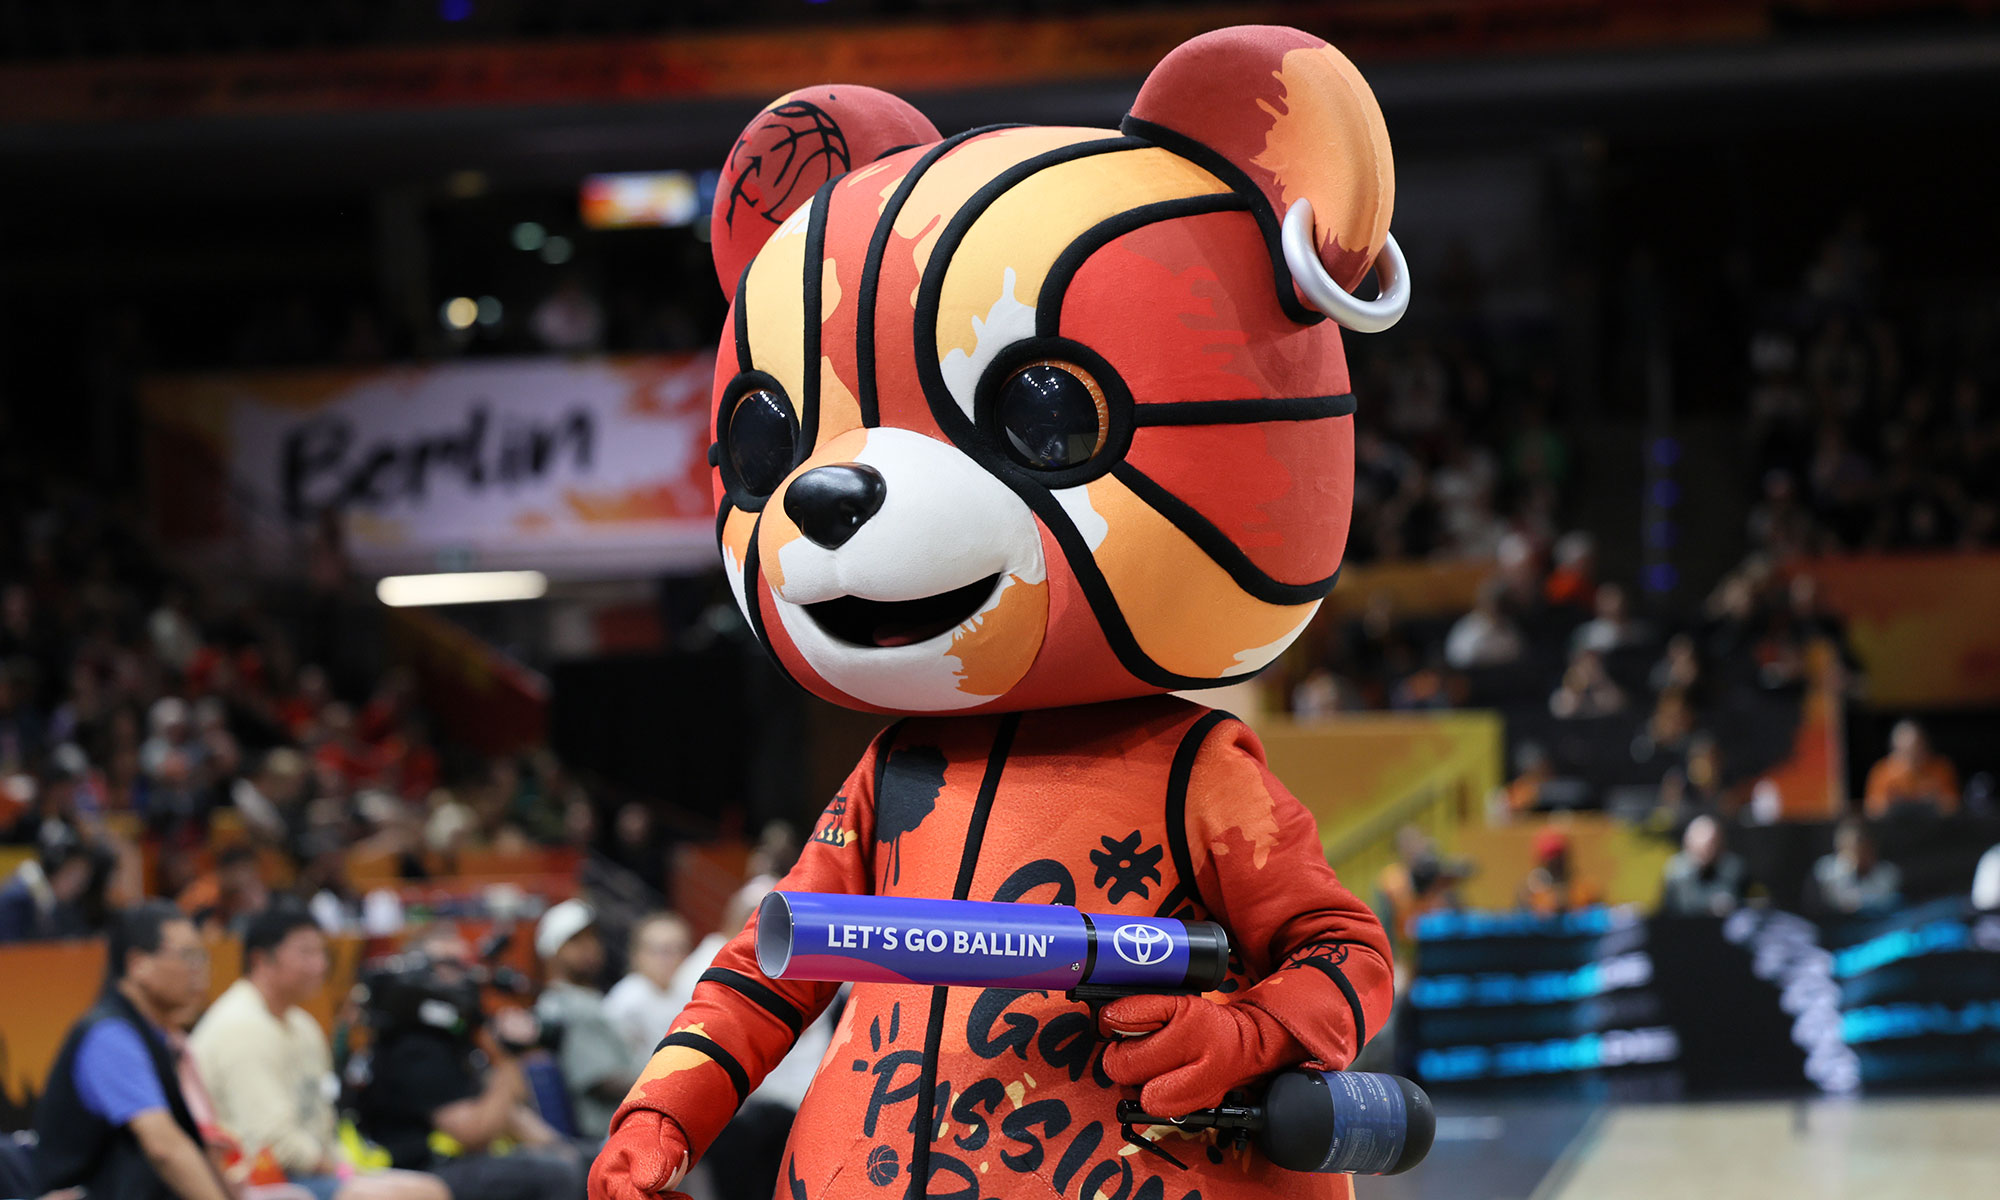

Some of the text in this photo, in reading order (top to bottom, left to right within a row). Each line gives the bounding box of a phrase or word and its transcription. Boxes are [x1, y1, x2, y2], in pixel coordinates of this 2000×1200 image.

[281, 404, 594, 519] Berlin
[828, 924, 1055, 958] LET'S GO BALLIN'
